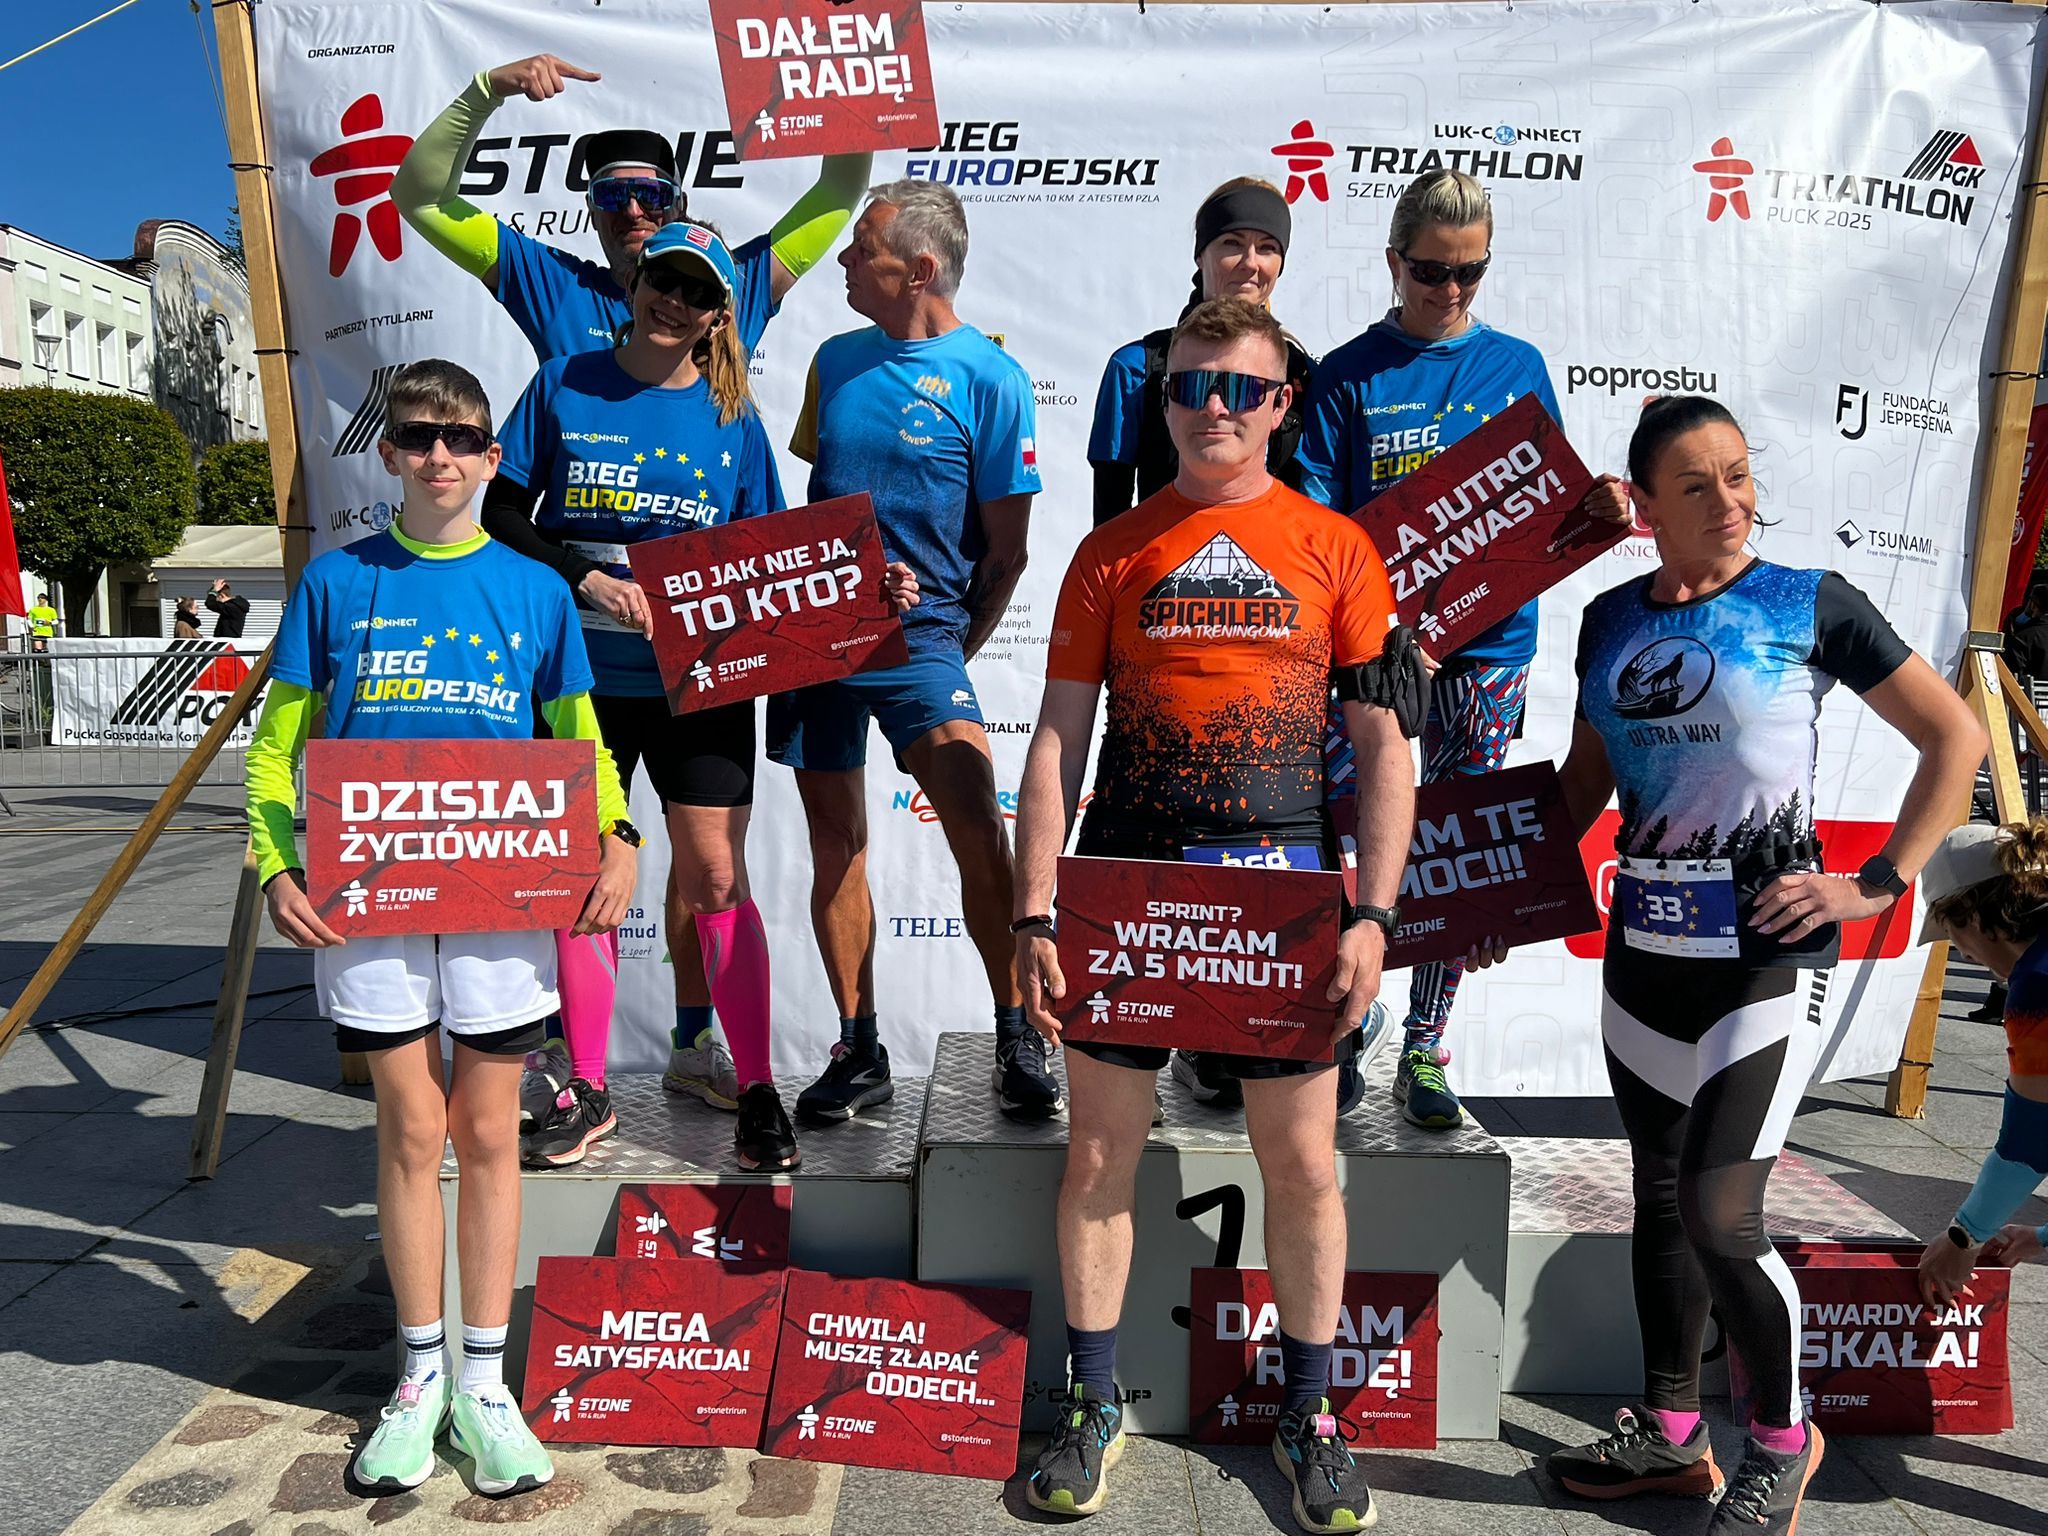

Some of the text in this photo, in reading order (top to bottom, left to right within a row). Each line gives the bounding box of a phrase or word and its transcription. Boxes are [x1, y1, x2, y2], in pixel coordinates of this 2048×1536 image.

[736, 13, 895, 58] DAŁEM
[308, 44, 395, 58] ORGANIZATOR
[780, 55, 913, 103] RADĘ!
[780, 115, 823, 129] STONE
[877, 113, 917, 123] @stonetrirun
[907, 122, 1019, 152] IEG
[906, 159, 1160, 186] EUROPEJSKI
[1346, 146, 1583, 181] TRIATHLON
[1940, 163, 1986, 189] PGK
[984, 194, 1026, 203] ULICZNY
[1028, 194, 1041, 203] NA
[1045, 194, 1057, 203] 10
[1059, 194, 1074, 203] KM
[1079, 194, 1086, 203] Z
[1087, 194, 1133, 203] ATESTEM
[1136, 194, 1160, 203] PZLA
[1346, 182, 1404, 199] SZEM
[1765, 169, 1975, 227] TRIATHLON
[1767, 207, 1872, 231] PUCK 2025
[325, 310, 433, 341] PARTNERZY TYTULARNI
[1568, 365, 1717, 396] poprostu
[1034, 395, 1077, 406] SKIEGO
[1883, 392, 1949, 416] FUNDACJA
[914, 420, 924, 428] BY
[1880, 409, 1953, 435] JEPPESENA
[899, 430, 934, 446] RUNEDA
[1371, 423, 1440, 457] BIEG
[568, 461, 639, 488] BIEG
[1424, 440, 1542, 534] JUTRO
[565, 487, 719, 526] EUROPEJSKI
[1389, 468, 1567, 602] ZAKWASY!
[1869, 530, 1932, 554] TSUNAMI
[663, 537, 858, 597] BO JAK NIE JA,
[670, 564, 863, 637] TO KTO?
[1442, 581, 1491, 620] STONE
[997, 619, 1031, 632] ealnych
[1138, 601, 1301, 630] SPICHLERZ
[1448, 617, 1460, 627] TRI
[1462, 606, 1475, 617] RUN
[831, 633, 879, 650] @stonetrirun
[1015, 634, 1051, 644] Kieturak
[1146, 624, 1291, 640] GRUPA TRENINGOWA
[357, 650, 428, 677] BIEG
[717, 653, 768, 676] STONE
[720, 675, 730, 683] TRI
[735, 672, 748, 681] RUN
[355, 678, 520, 713] EUROPEJSKI
[362, 706, 380, 714] 2025
[400, 705, 431, 713] ULICZNY
[446, 706, 453, 714] 10
[65, 728, 173, 742] Pucka Gospodarka
[984, 722, 1031, 734] DIALNI
[1628, 723, 1722, 748] ULTRA WAY
[341, 779, 565, 822] DZISIAJ
[1474, 797, 1545, 842] TĘ
[339, 823, 569, 862] ŻYCIÓWKA!
[375, 887, 439, 903] STONE
[514, 888, 571, 899] @stonetrirun
[1146, 901, 1243, 923] SPRINT?
[1514, 900, 1567, 916] @stonetrirun
[1645, 894, 1684, 922] 33
[619, 923, 656, 938] mud
[889, 918, 966, 938] TELE
[1113, 921, 1277, 957] WRACAM
[1395, 917, 1446, 938] STONE
[1088, 949, 1303, 990] ZA 5 MINUT!
[1117, 1002, 1175, 1018] STONE
[1248, 1017, 1305, 1029] @stonetrirun
[600, 1310, 711, 1342] MEGA
[1800, 1304, 1985, 1327] TWARDY JAK
[808, 1312, 926, 1345] CHWILA!
[554, 1344, 750, 1371] SATYSFAKCJA!
[804, 1340, 979, 1374] MUSZĘ ZŁAPAĆ
[1799, 1331, 1980, 1368] SKAŁA!
[1256, 1346, 1412, 1399] RDĘ!
[866, 1371, 995, 1406] ODDECH...
[1821, 1395, 1870, 1406] STONE
[578, 1397, 632, 1412] STONE
[696, 1406, 747, 1415] @stonetrirun
[1245, 1403, 1279, 1417] STO
[1362, 1410, 1411, 1420] @stonetrirun
[1932, 1399, 1978, 1407] @stonetrirun
[823, 1416, 877, 1434] STONE
[837, 1432, 851, 1440] RUN
[941, 1433, 991, 1445] @stonetrirun
